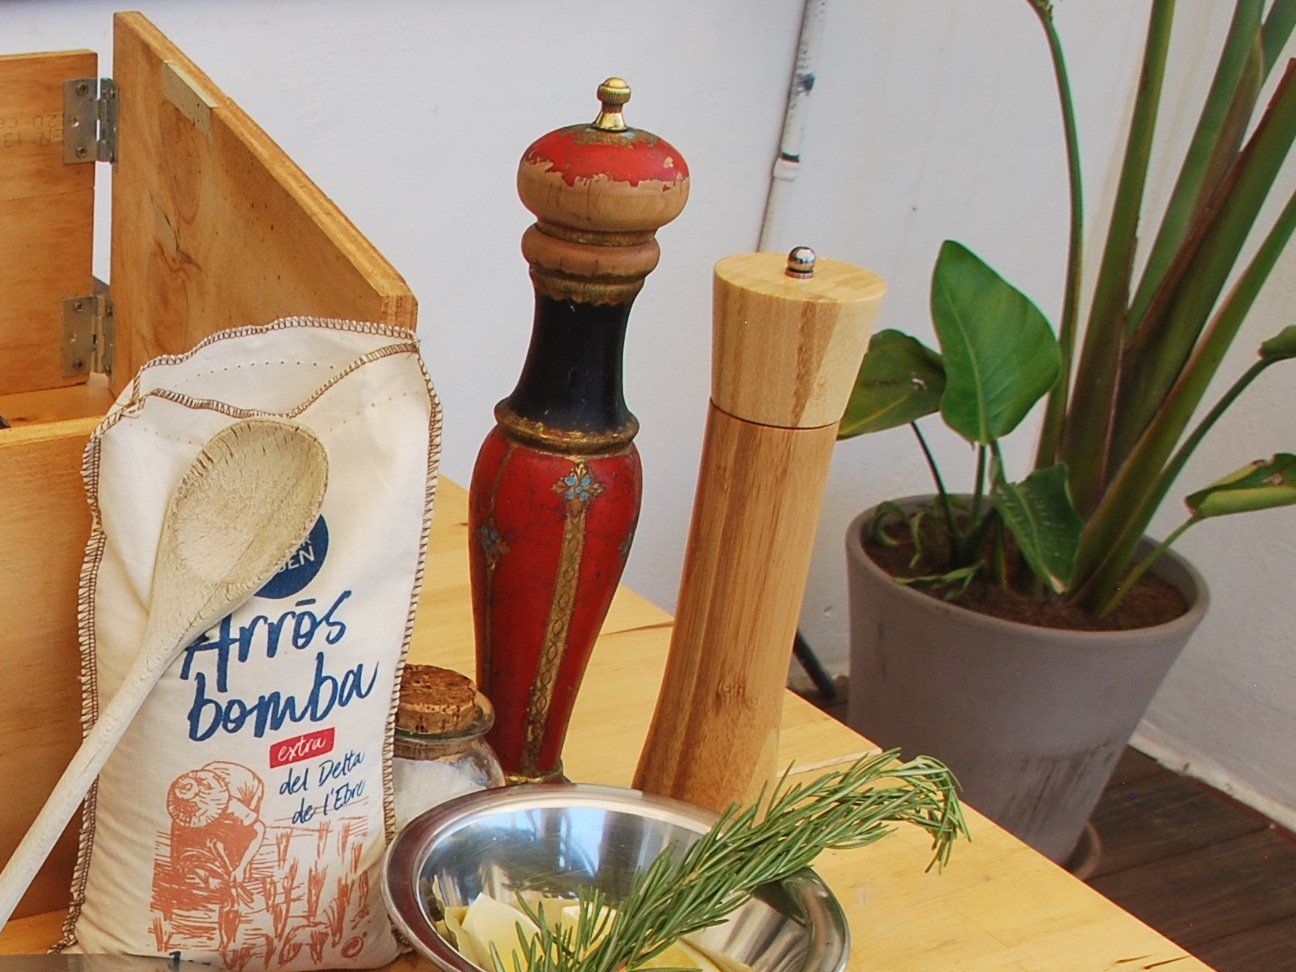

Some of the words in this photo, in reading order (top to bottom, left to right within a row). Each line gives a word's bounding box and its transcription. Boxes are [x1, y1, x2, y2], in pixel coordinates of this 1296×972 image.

[187, 651, 380, 742] bomba
[277, 734, 328, 762] extra
[279, 767, 309, 796] del
[318, 749, 366, 788] Delta
[291, 798, 316, 825] de
